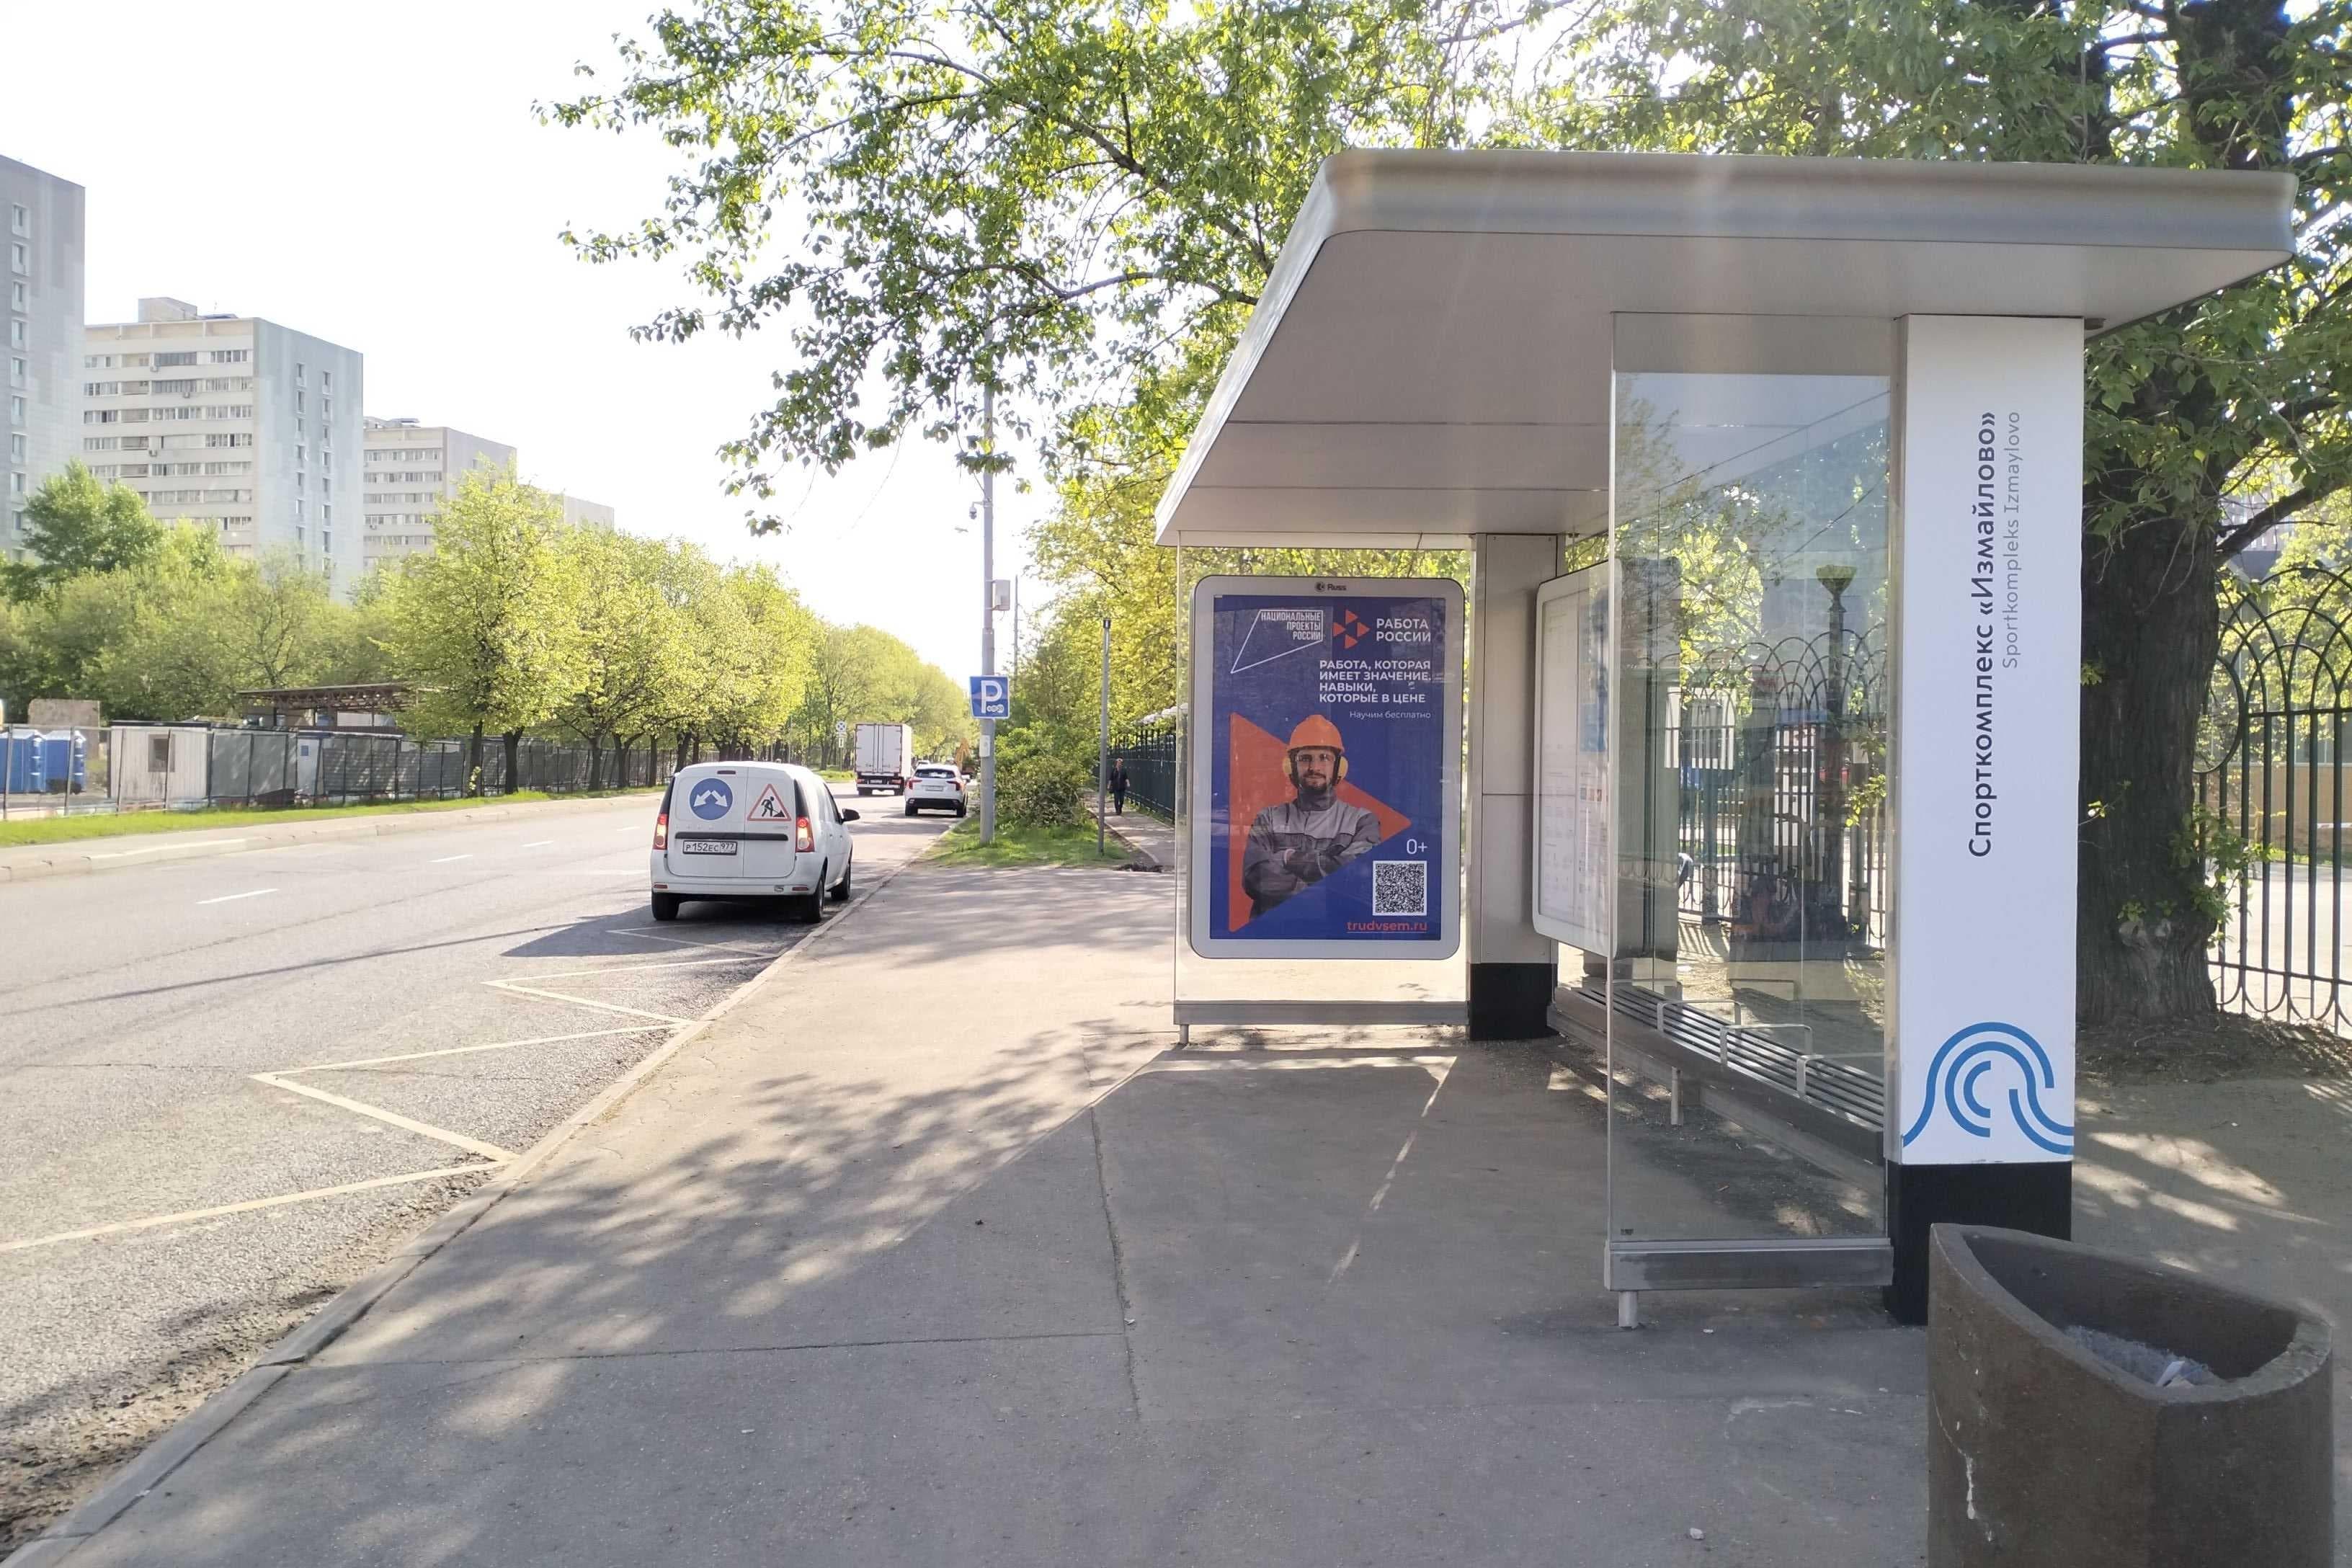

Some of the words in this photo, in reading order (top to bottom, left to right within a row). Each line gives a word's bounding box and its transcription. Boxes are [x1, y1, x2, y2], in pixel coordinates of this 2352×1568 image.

[2004, 412, 2023, 513] Izmaylovo
[1972, 412, 1995, 615] «Измайлово»
[2003, 520, 2021, 668] Sportkompleks
[1261, 612, 1321, 621] НАЦИОНАЛЬНЫЕ
[1286, 621, 1321, 631] ПРОЕКТЫ
[1376, 618, 1428, 629] РАБОТА
[1293, 631, 1321, 641] РОССИИ
[1376, 631, 1431, 642] РОССИИ
[1319, 660, 1371, 671] РАБОТА,
[1374, 660, 1430, 669] КОТОРАЯ
[1319, 672, 1360, 680] ИМЕЕТ
[1363, 672, 1431, 681] ЗНАЧЕНИЕ.
[1319, 682, 1376, 692] НАВЫКИ,
[1319, 694, 1378, 703] КОТОРЫЕ
[1381, 694, 1389, 703] В
[1393, 694, 1425, 704] ЦЕНЕ
[1350, 710, 1383, 720] Научим
[1385, 710, 1430, 719] бесплатно
[1969, 625, 1997, 857] Спорткомплекс
[1407, 839, 1427, 855] 0+
[1347, 921, 1427, 931] trudvsem.ru
